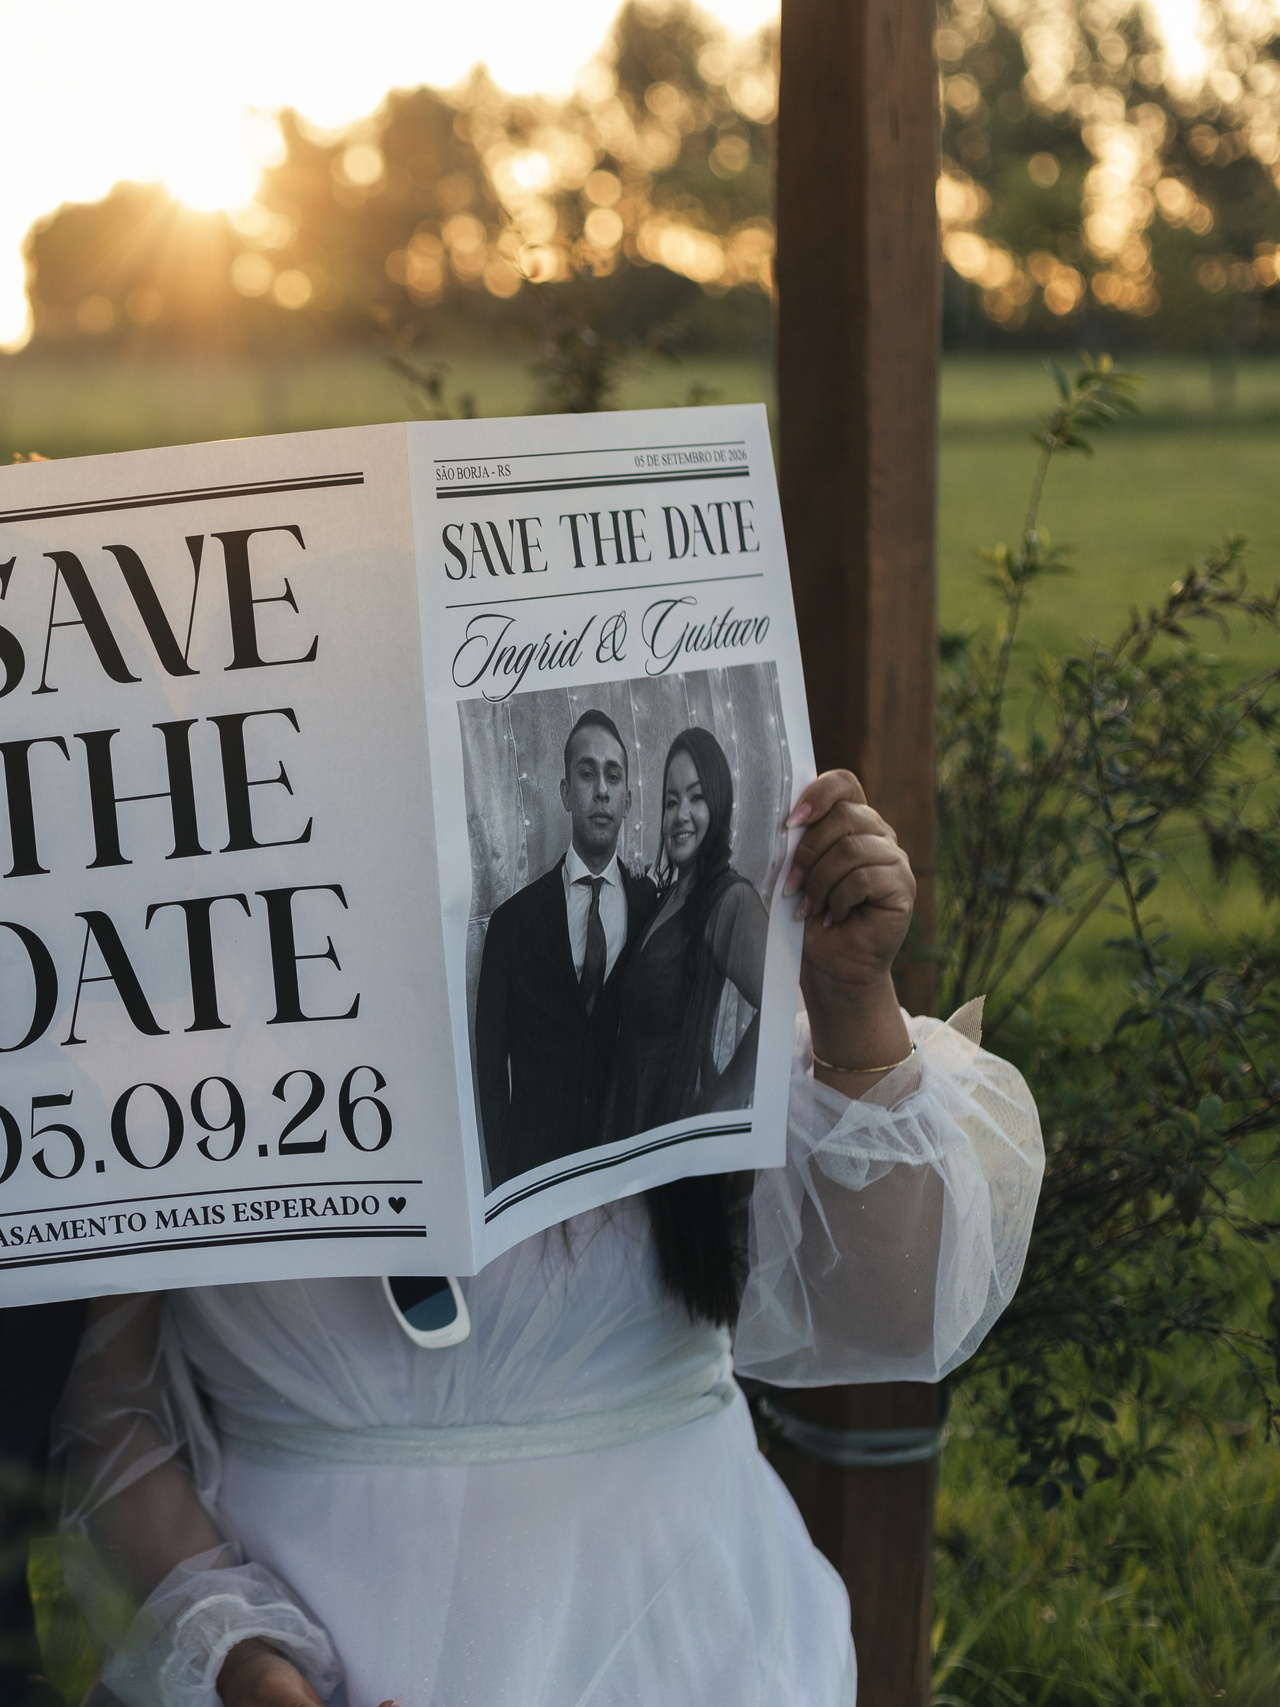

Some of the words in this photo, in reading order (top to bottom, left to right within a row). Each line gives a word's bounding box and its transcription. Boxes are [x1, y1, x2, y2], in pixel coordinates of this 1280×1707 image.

[435, 465, 455, 481] SÃO
[456, 466, 490, 480] BORJA
[497, 464, 512, 478] RS
[634, 455, 645, 468] 05
[646, 454, 661, 467] DE
[661, 451, 713, 466] SETEMBRO
[714, 449, 728, 462] DE
[728, 448, 748, 461] 2026
[441, 516, 548, 581] SAVE
[558, 508, 652, 569] THE
[661, 500, 761, 560] DATE
[452, 613, 598, 702] Ingrid
[595, 610, 628, 664] &
[640, 595, 771, 677] Gustavo
[155, 1204, 226, 1231] MAIS
[233, 1194, 381, 1223] ESPERADO
